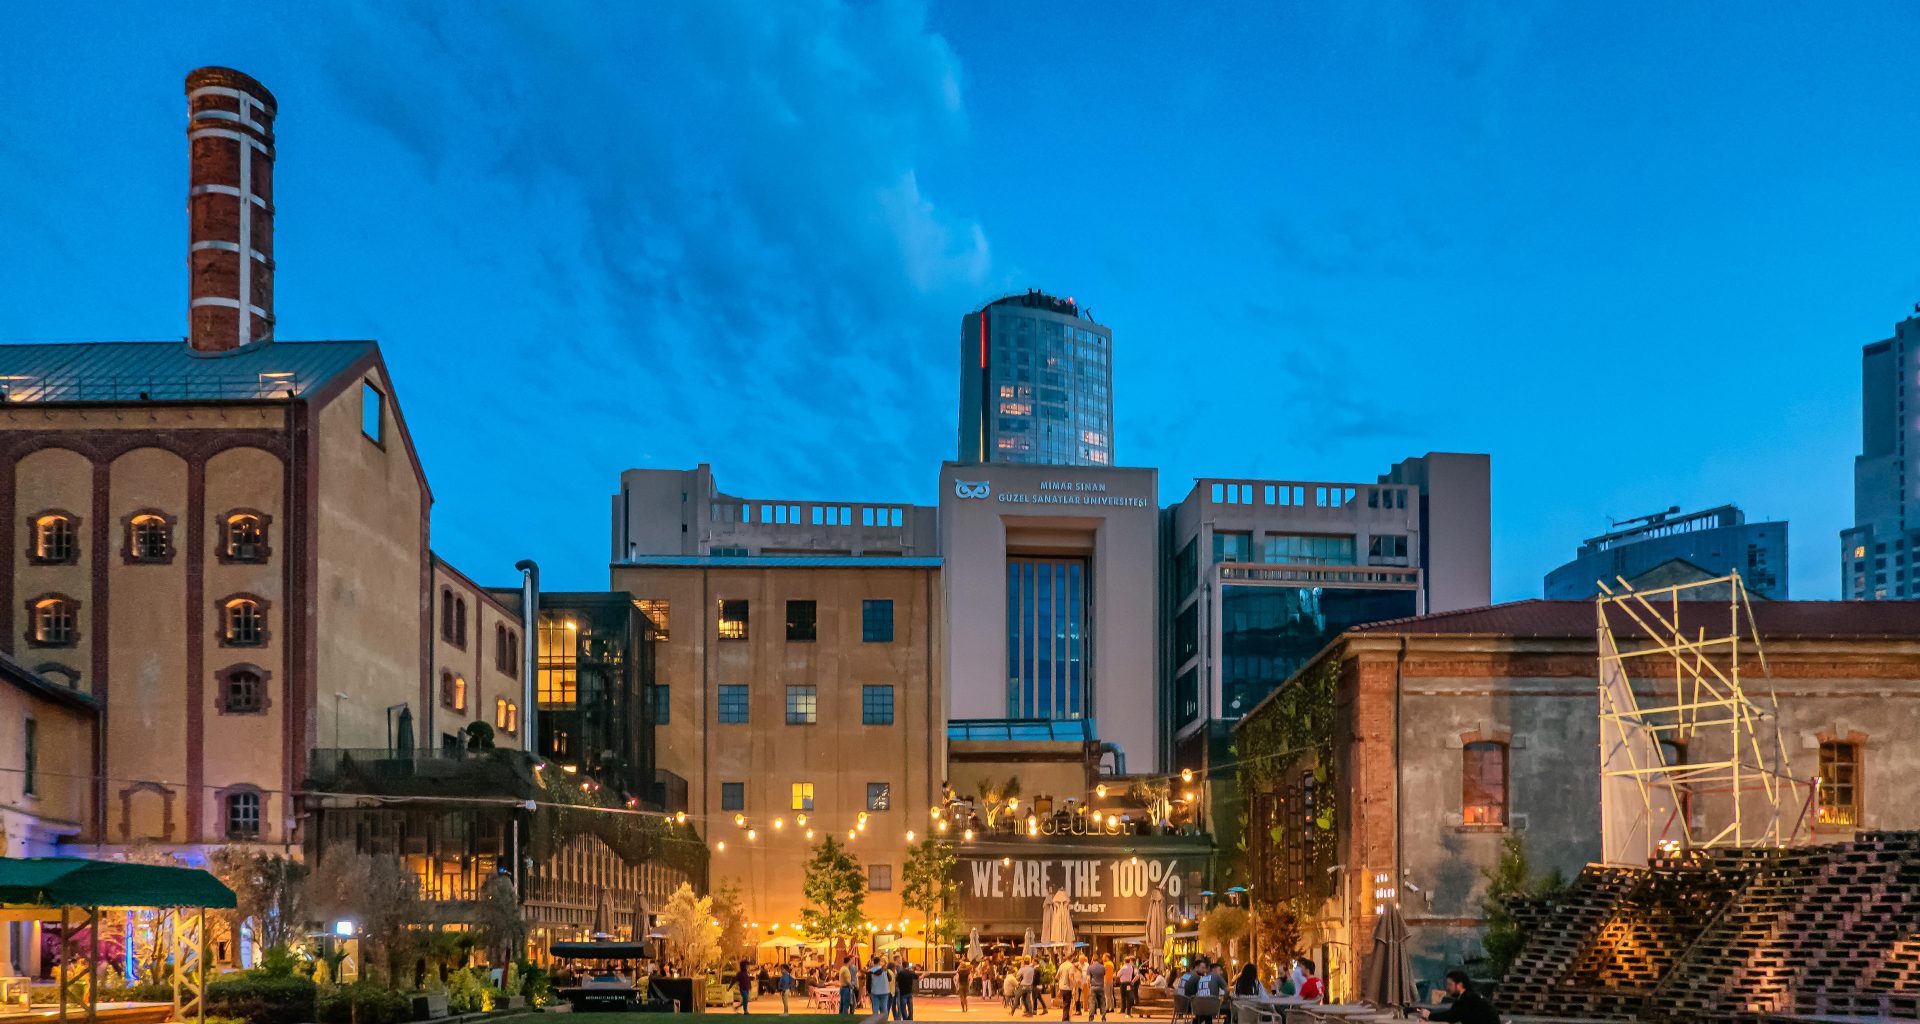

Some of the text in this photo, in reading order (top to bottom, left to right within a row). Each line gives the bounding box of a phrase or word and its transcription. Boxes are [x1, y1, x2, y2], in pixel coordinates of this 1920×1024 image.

[1032, 494, 1081, 505] SANATLAR
[971, 859, 1181, 898] WE ARE THE 100%
